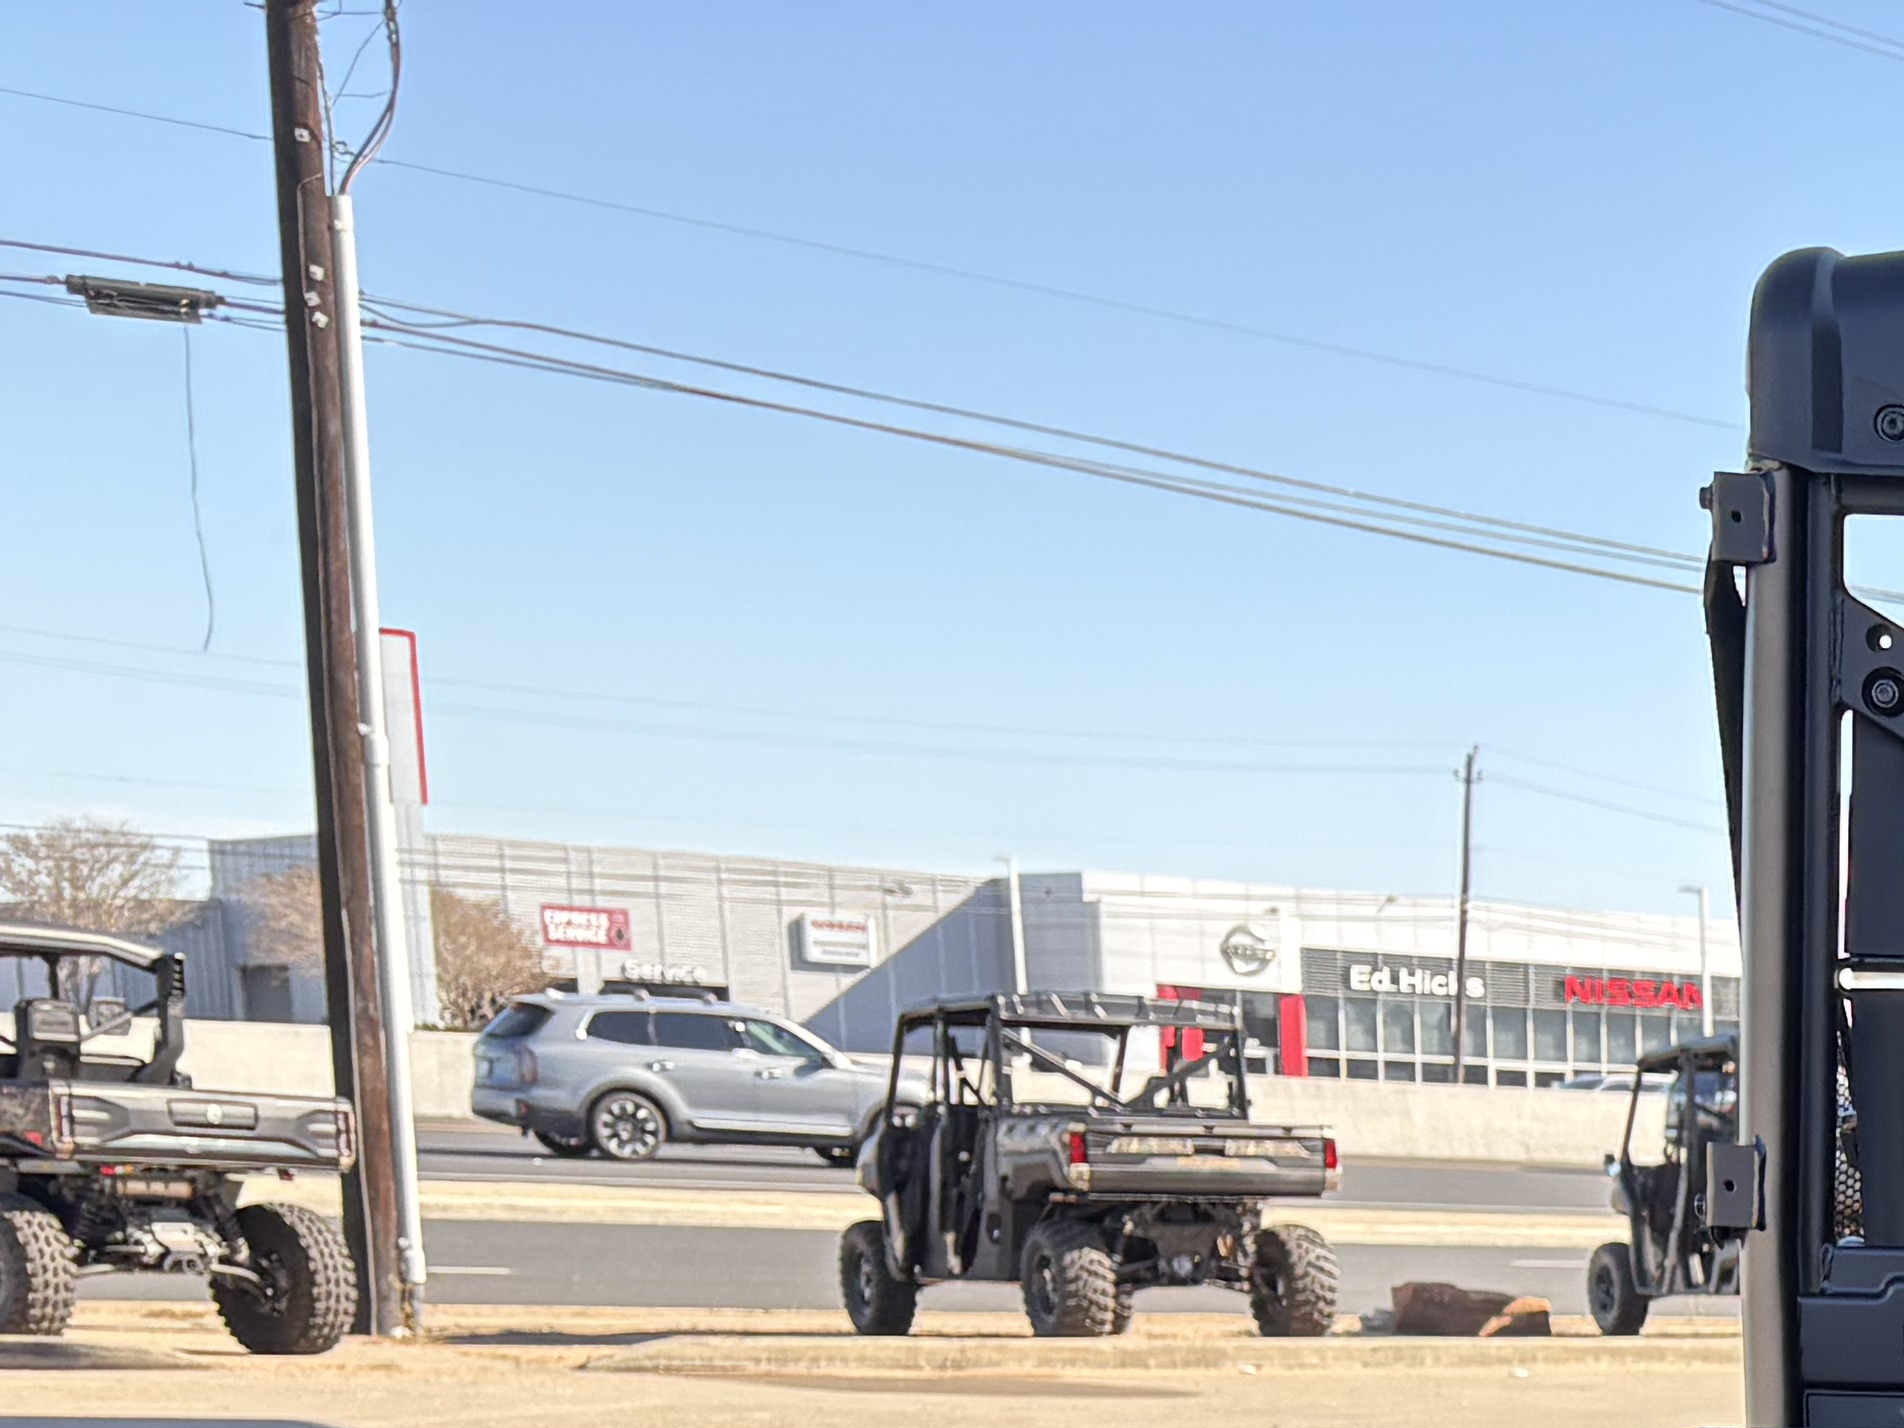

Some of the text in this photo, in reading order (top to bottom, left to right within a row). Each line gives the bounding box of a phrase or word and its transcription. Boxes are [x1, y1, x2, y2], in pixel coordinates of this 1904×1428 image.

[622, 960, 707, 983] Service
[1350, 964, 1397, 992] Ed
[1564, 975, 1704, 1010] NISSAN
